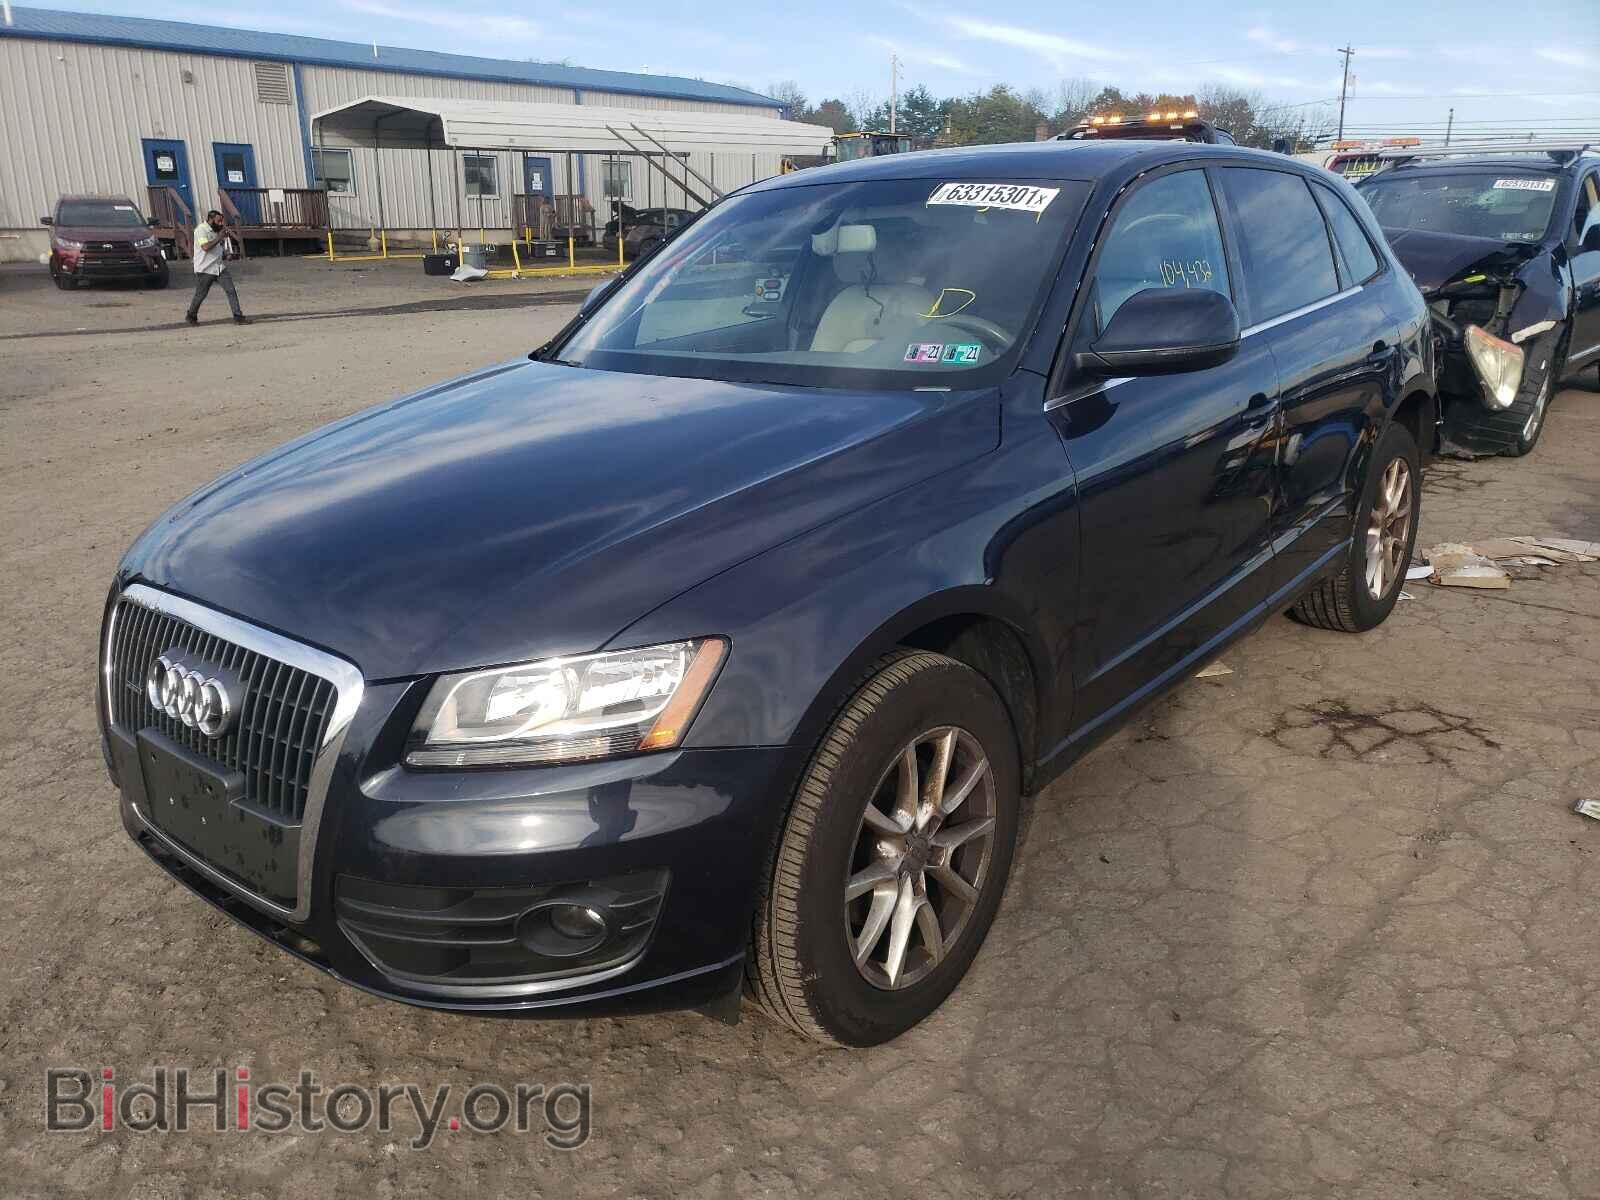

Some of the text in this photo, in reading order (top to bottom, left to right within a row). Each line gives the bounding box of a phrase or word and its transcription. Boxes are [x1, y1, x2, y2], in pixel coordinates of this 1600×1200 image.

[916, 288, 976, 318] D
[927, 345, 940, 358] 21
[965, 346, 979, 360] 21
